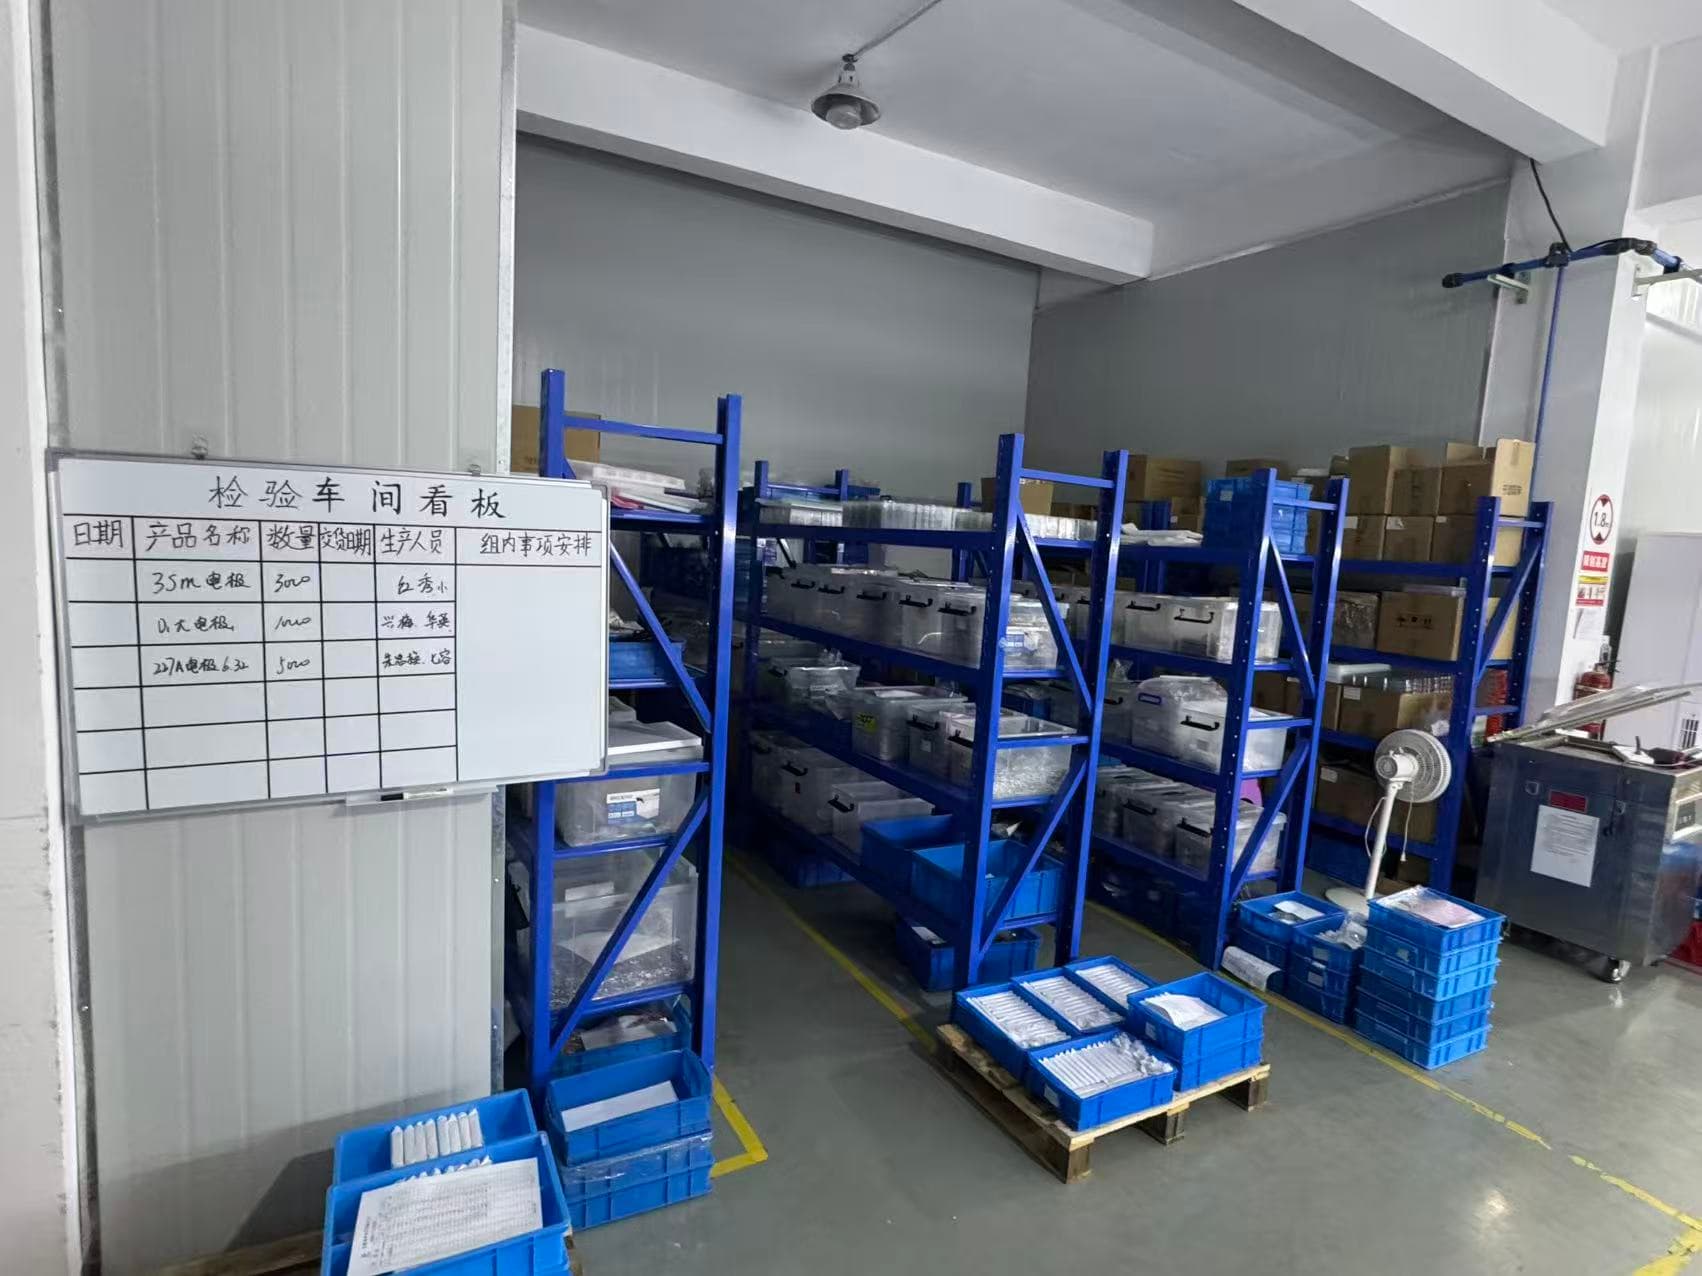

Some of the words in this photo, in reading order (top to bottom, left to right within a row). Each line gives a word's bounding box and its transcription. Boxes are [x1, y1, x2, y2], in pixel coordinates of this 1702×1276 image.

[209, 475, 507, 519] 检验车间看板
[73, 519, 124, 549] 日期
[146, 520, 252, 552] 产品名称
[266, 523, 316, 551] 数量
[320, 526, 372, 556] 交货日期
[380, 526, 443, 556] 生产人员
[479, 531, 592, 558] 组内事项安排
[274, 573, 311, 593] 3000
[276, 655, 311, 675] 5000
